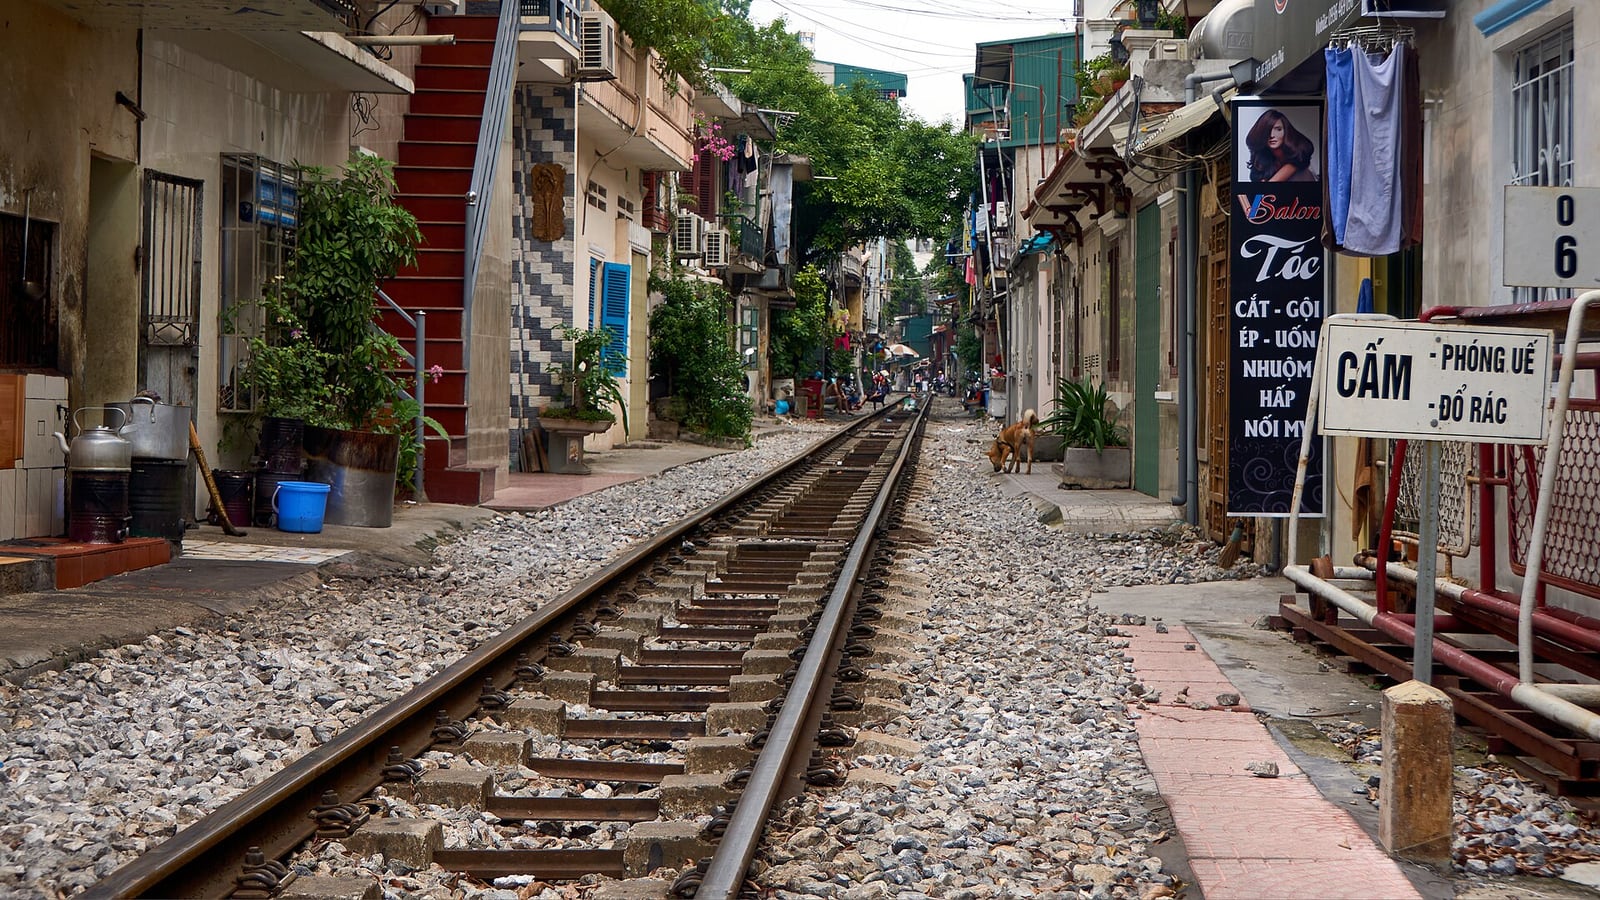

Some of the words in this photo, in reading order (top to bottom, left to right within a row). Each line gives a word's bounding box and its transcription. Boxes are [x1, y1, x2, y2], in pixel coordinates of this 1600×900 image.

[1240, 234, 1320, 282] Tóc
[1235, 293, 1270, 318] CẮT
[1286, 296, 1320, 322] GỘI
[1239, 326, 1259, 348] ÉP
[1275, 324, 1316, 348] UỐN
[1243, 356, 1312, 381] NHUỘM
[1336, 337, 1413, 401] CẤM
[1441, 339, 1505, 373] PHÓNG
[1511, 339, 1538, 375] UẾ
[1259, 384, 1296, 408] HẤP
[1439, 384, 1467, 422] ĐỔ
[1469, 391, 1508, 424] RÁC
[1244, 414, 1279, 437] NỐI
